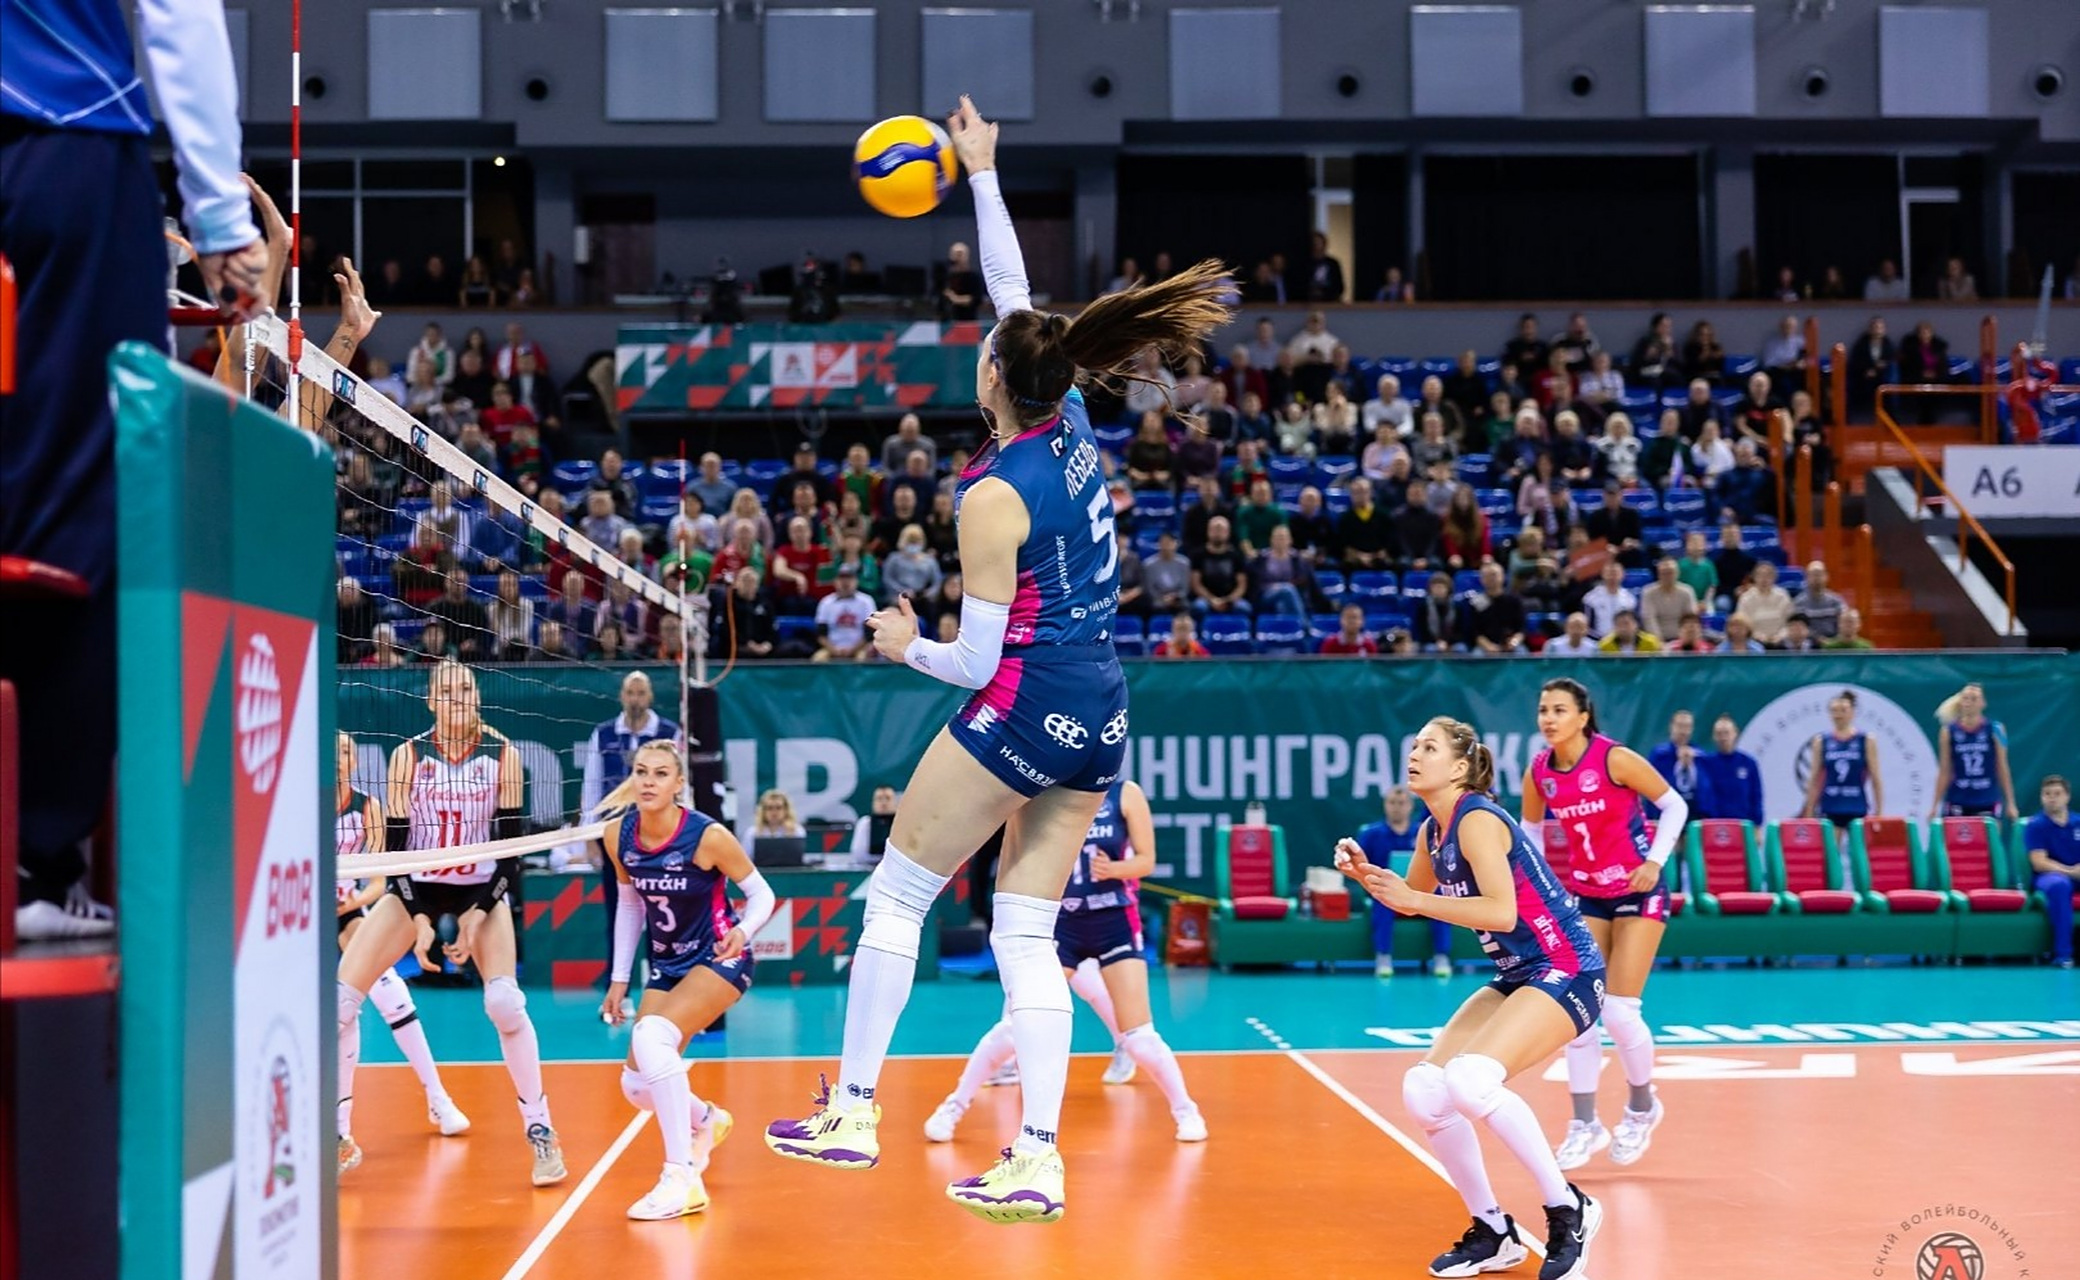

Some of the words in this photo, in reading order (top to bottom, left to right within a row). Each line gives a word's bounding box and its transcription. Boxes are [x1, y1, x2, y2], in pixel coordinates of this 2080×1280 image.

[1971, 464, 2023, 498] A6
[1086, 484, 1118, 585] 5
[1962, 752, 1985, 776] 12
[646, 895, 677, 932] 3
